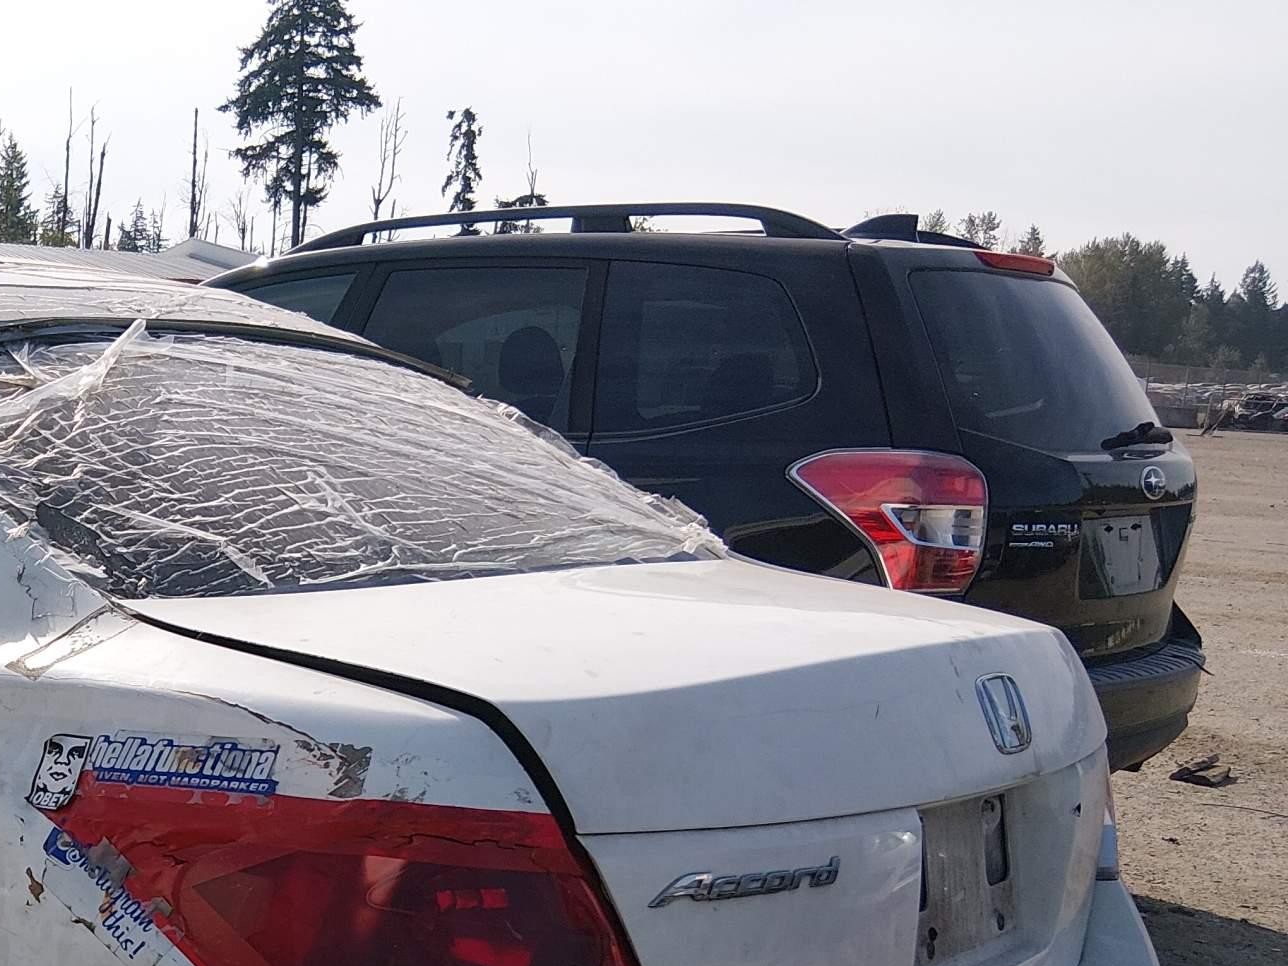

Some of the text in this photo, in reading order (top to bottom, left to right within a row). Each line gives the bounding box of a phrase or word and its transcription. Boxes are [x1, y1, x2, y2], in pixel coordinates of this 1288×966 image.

[1011, 523, 1079, 536] SUBARU
[93, 737, 276, 780] hellafunctiona
[137, 774, 167, 784] NOT
[170, 776, 269, 792] HARDPARKED
[32, 791, 69, 808] OBEY
[648, 855, 841, 908] Accord
[102, 909, 146, 960] this!
